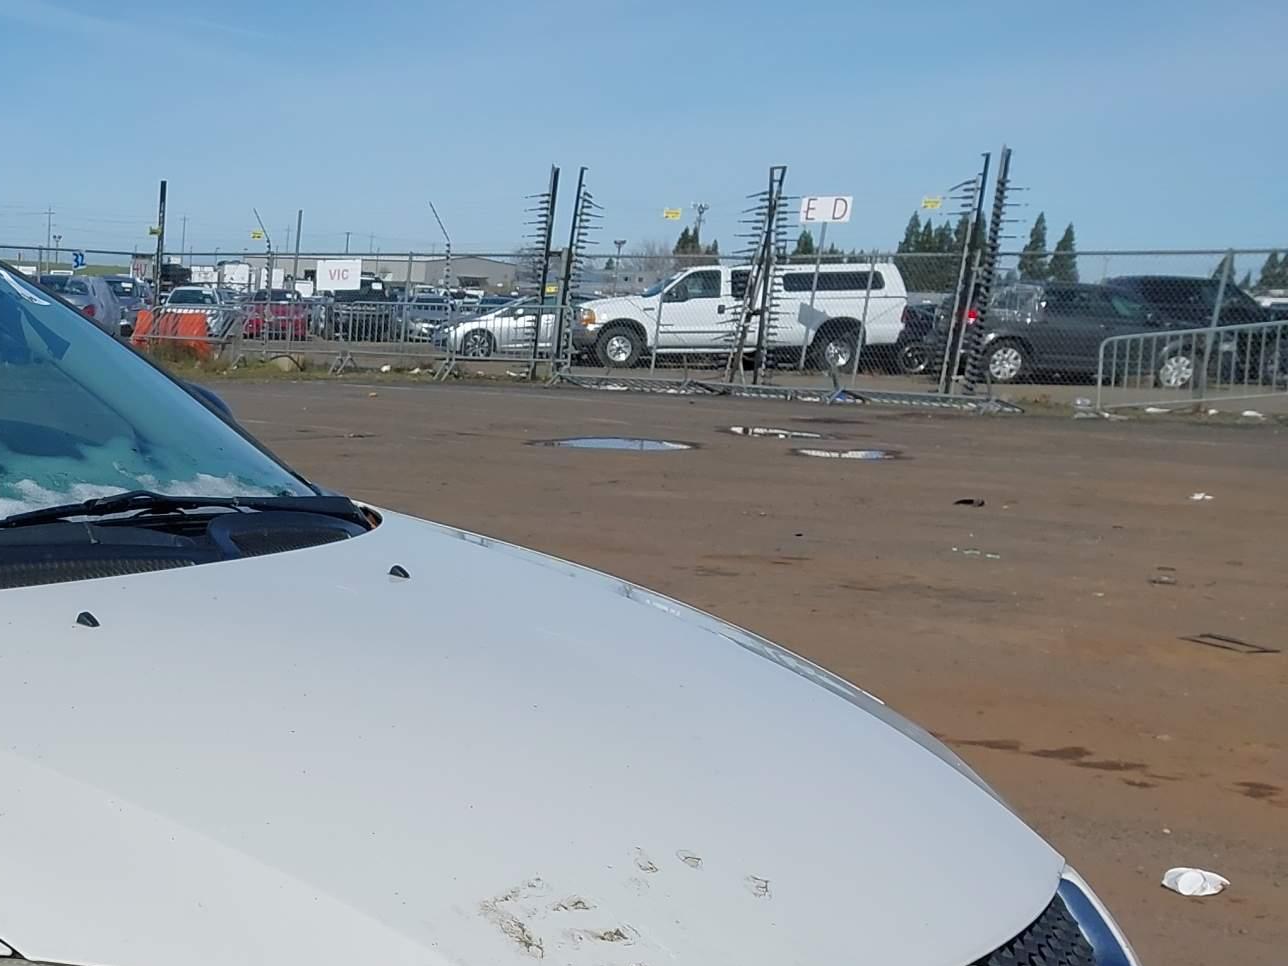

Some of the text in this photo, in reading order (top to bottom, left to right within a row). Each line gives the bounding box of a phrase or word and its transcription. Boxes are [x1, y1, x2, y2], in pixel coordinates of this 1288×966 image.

[805, 198, 848, 220] E D
[73, 252, 86, 269] 32
